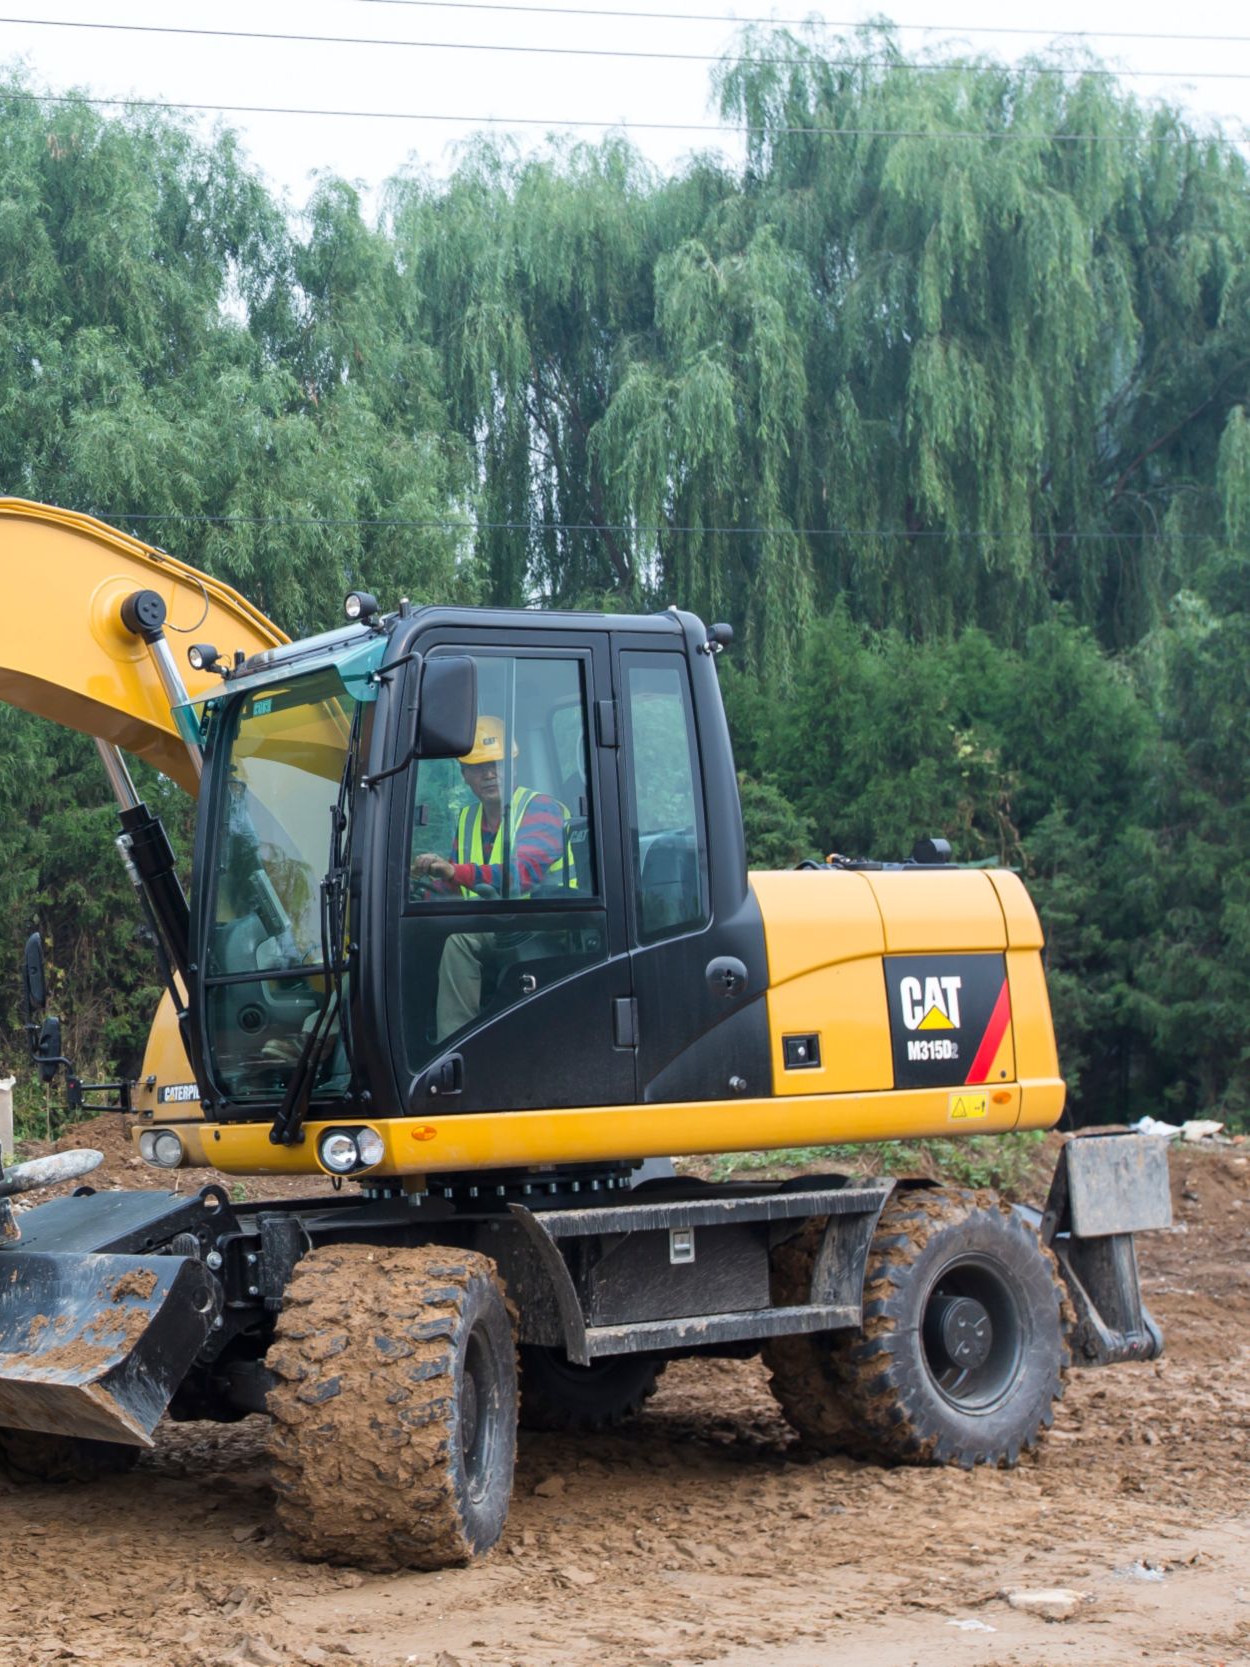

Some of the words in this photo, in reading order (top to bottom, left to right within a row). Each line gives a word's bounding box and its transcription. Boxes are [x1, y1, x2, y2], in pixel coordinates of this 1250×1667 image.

[570, 829, 589, 843] CAT
[900, 976, 962, 1030] CAT
[907, 1039, 959, 1061] M315D2
